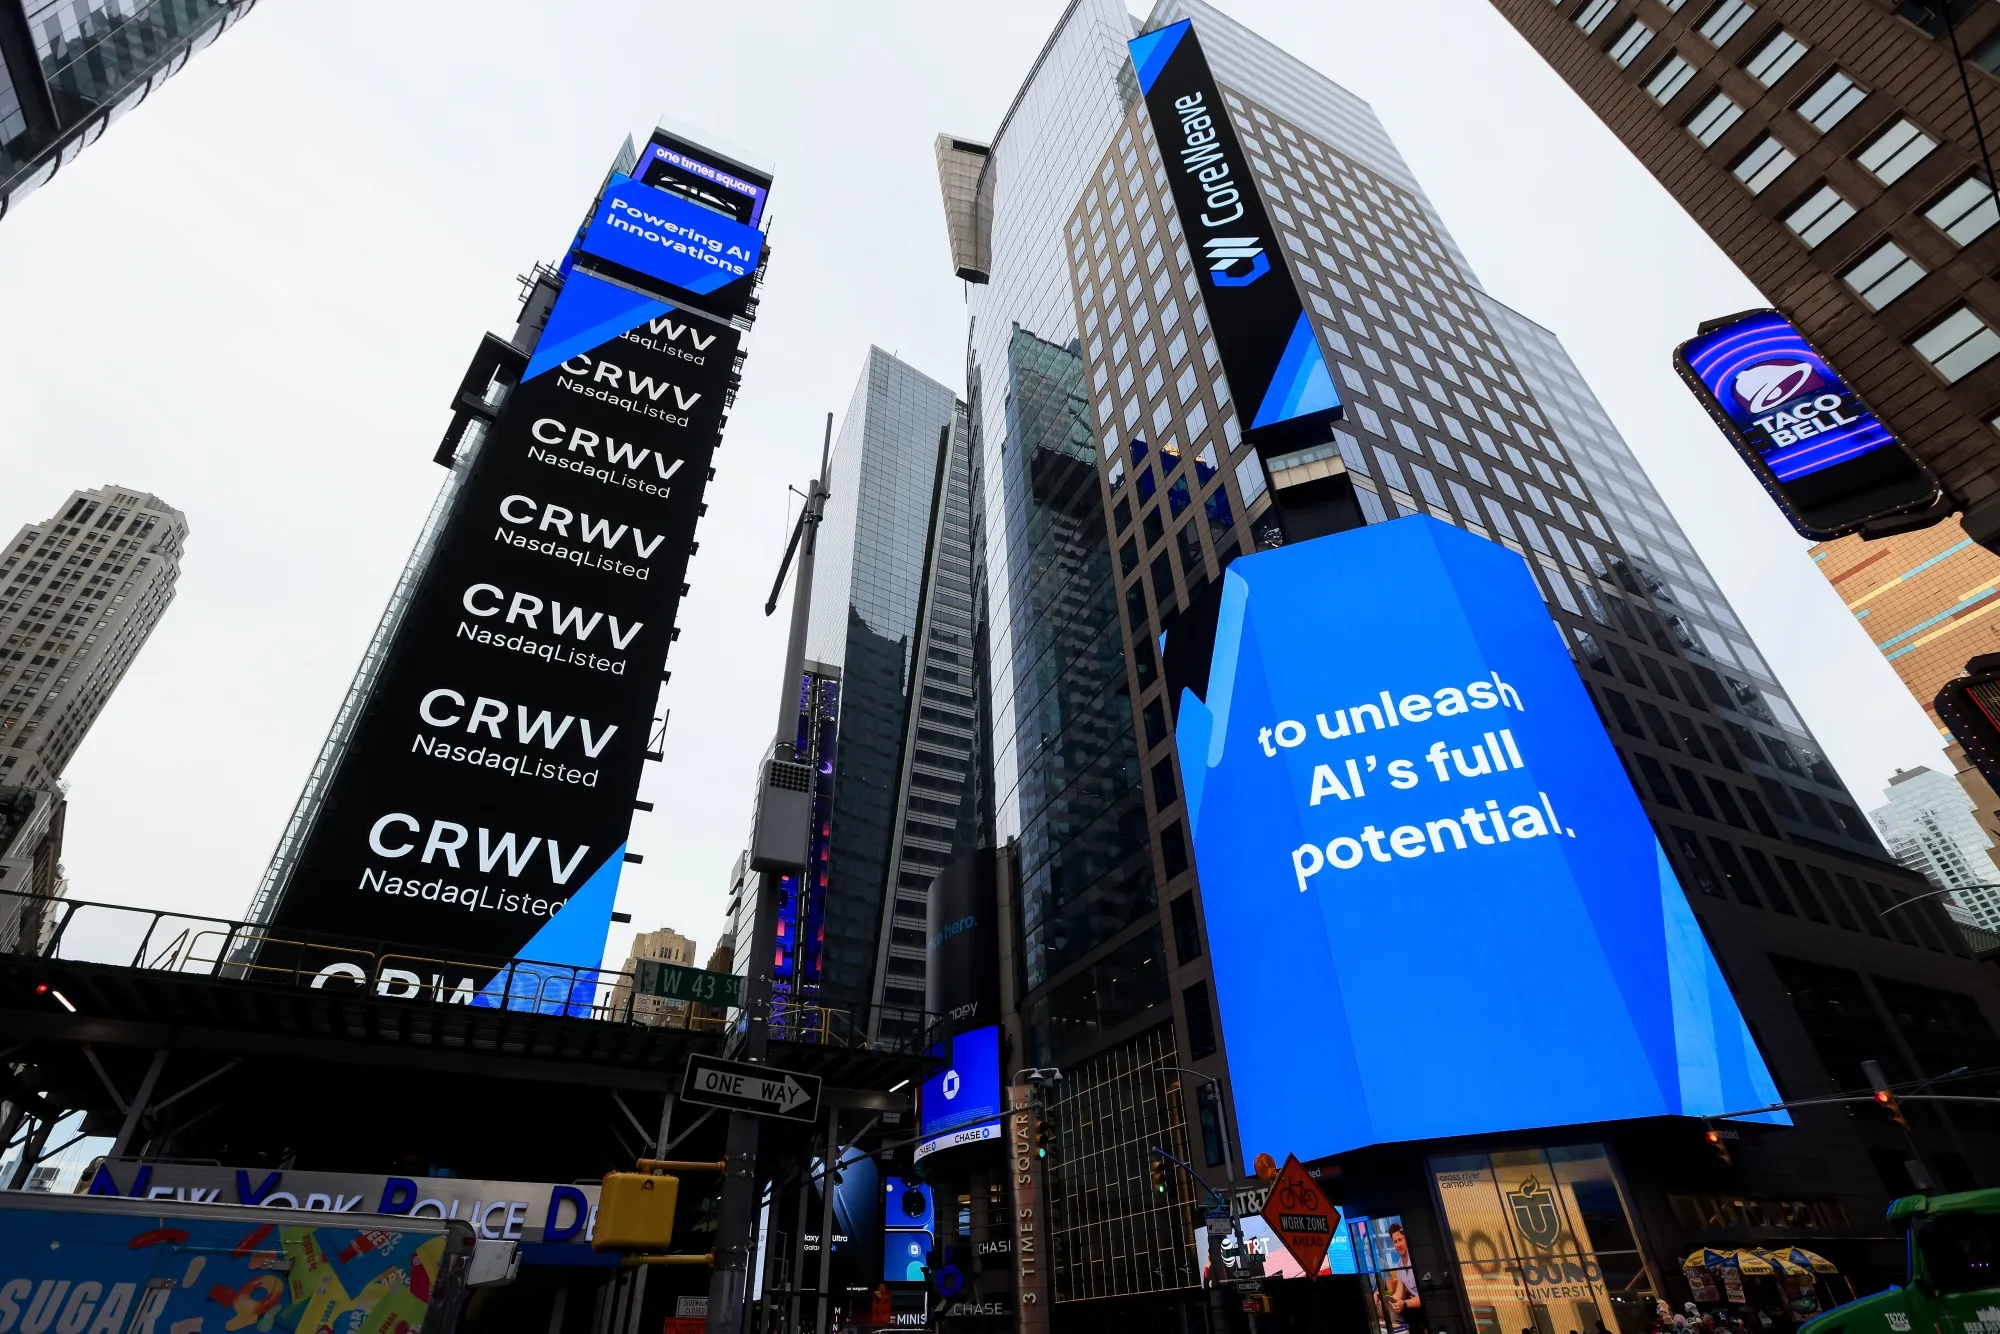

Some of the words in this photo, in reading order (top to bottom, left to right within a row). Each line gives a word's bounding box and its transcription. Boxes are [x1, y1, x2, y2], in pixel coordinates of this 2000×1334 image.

[656, 148, 680, 164] one
[681, 156, 715, 179] times
[716, 173, 757, 195] square
[1175, 91, 1244, 227] CoreWeave
[606, 213, 745, 276] Innovations
[611, 198, 722, 252] Powering
[726, 246, 751, 262] AI
[649, 318, 717, 352] WV
[556, 375, 689, 428] NasdaqListed
[560, 354, 702, 411] CRWV
[1753, 394, 1842, 434] TACO
[1770, 410, 1859, 448] BELL
[527, 445, 671, 499] NasdaqListed
[531, 418, 685, 480] CRWV
[499, 494, 666, 559] CRWV
[494, 526, 650, 581] NasdaqListed
[462, 583, 644, 651] CRWV
[455, 620, 627, 676] NasdaqListed
[418, 688, 619, 759] CRWV
[1257, 719, 1307, 758] to
[1315, 670, 1525, 740] unleash
[411, 733, 600, 788] NasdaqListed
[1425, 729, 1525, 782] full
[368, 812, 591, 885] CRWV
[1291, 791, 1576, 893] potential.
[663, 968, 683, 994] W
[692, 974, 715, 1000] 43
[725, 979, 739, 994] St
[705, 1072, 745, 1095] ONE
[761, 1081, 799, 1104] WAY
[954, 1130, 981, 1144] CHASE
[1439, 1174, 1460, 1182] cross
[1441, 1180, 1474, 1189] campus
[804, 1233, 820, 1243] laxy
[831, 1234, 848, 1242] Ultra
[1019, 1207, 1036, 1278] TIMES
[1280, 1215, 1305, 1231] WORK
[1306, 1216, 1329, 1231] ZONE
[1292, 1236, 1324, 1247] AHEAD
[1022, 1292, 1037, 1304] 3
[1505, 1260, 1603, 1286] TOURO
[1514, 1284, 1603, 1300] UNIVERSITY
[0, 1278, 172, 1334] SUGAR
[953, 1302, 1004, 1316] CHASE
